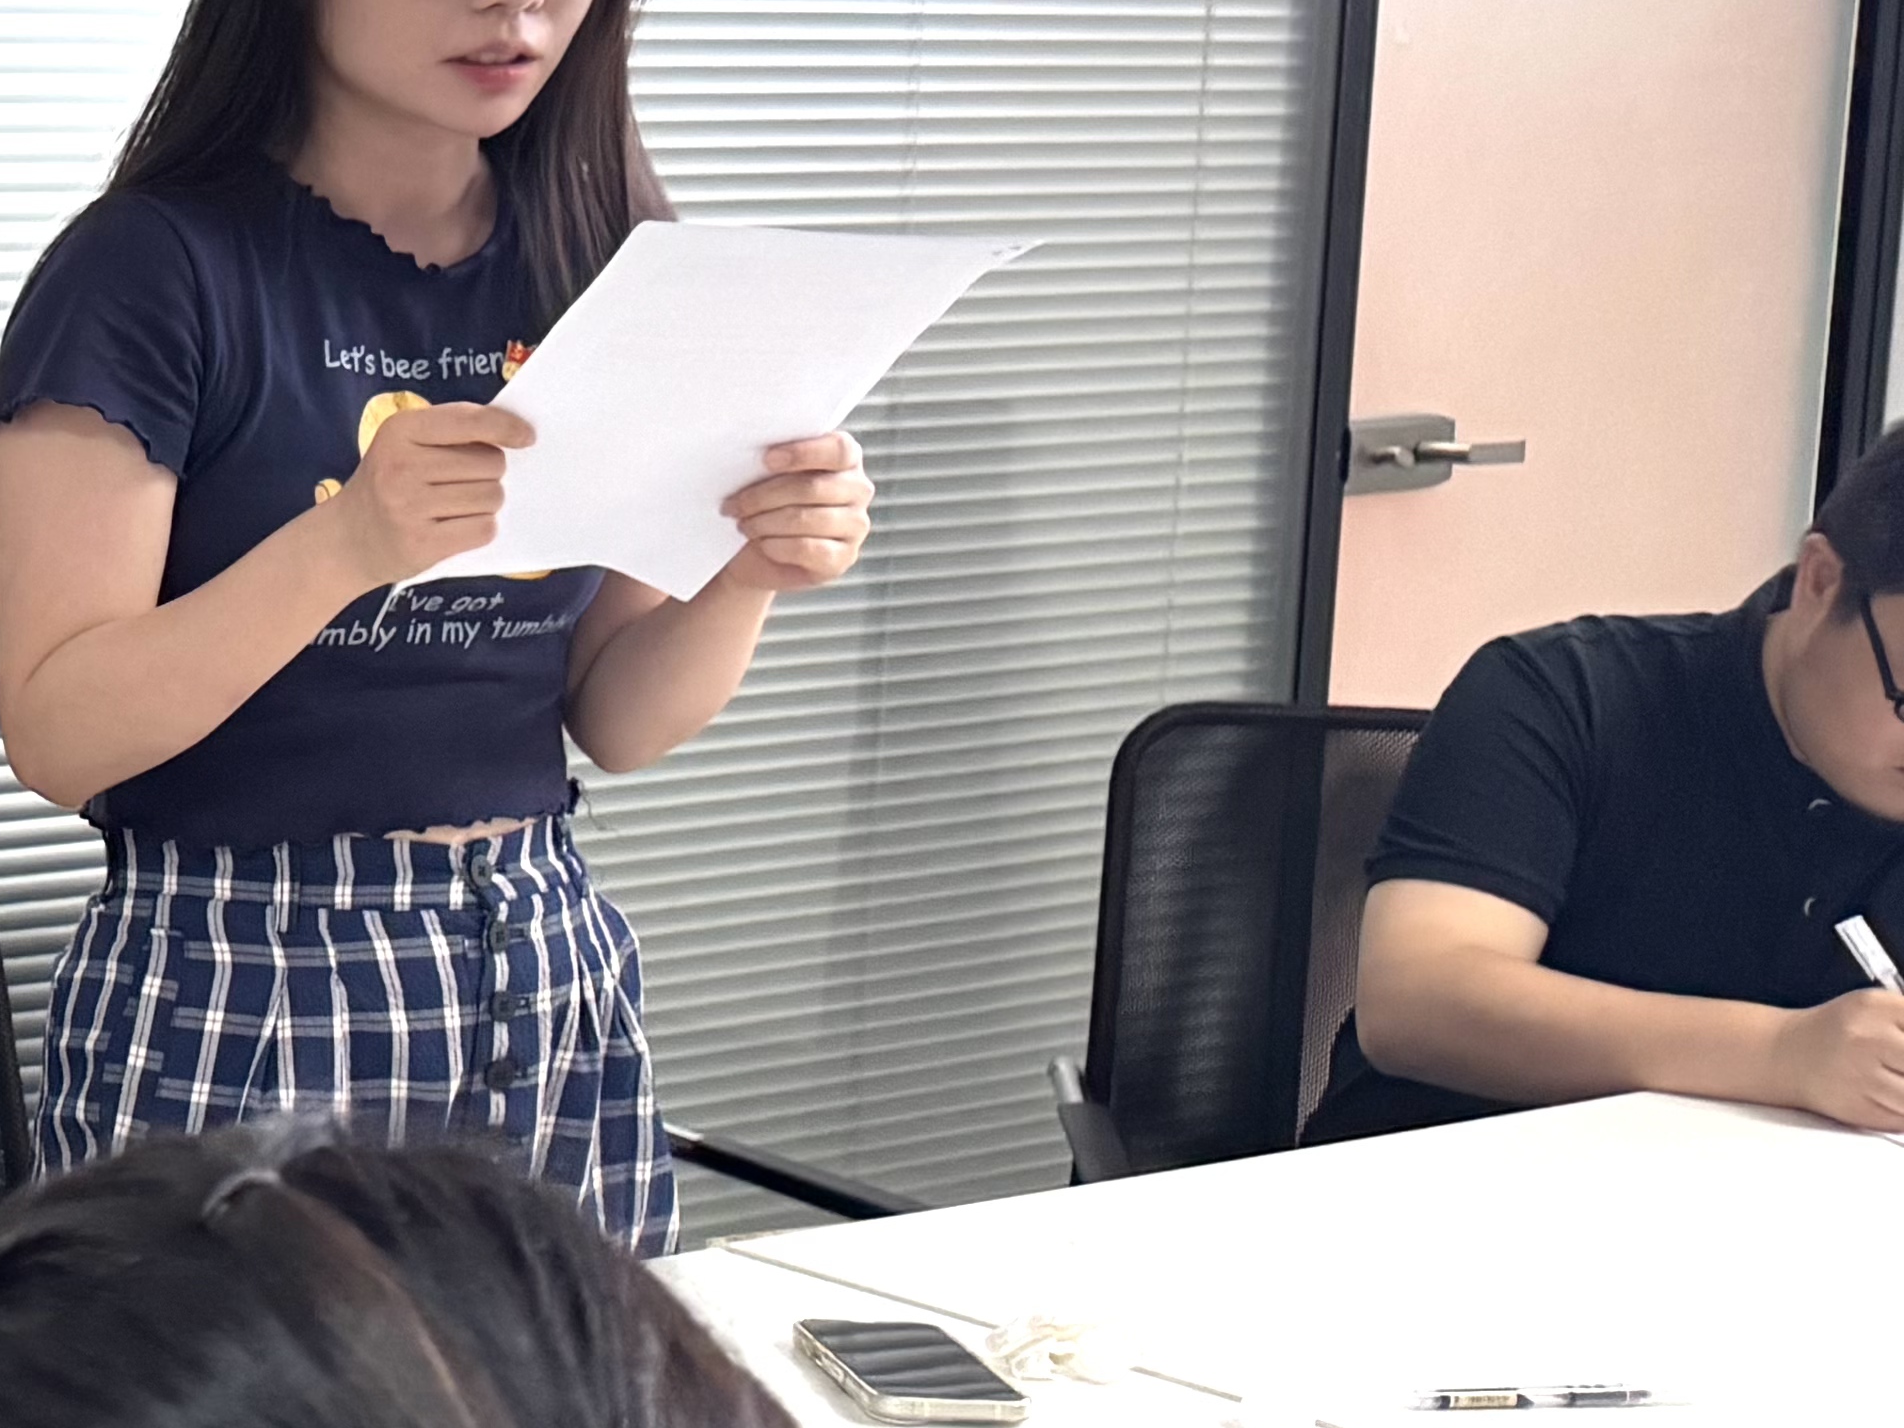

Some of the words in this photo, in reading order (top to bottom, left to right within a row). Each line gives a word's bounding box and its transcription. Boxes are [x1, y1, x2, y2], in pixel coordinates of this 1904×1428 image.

[324, 339, 375, 375] Let's
[380, 349, 430, 380] bee
[438, 348, 504, 380] frien
[388, 589, 442, 613] I've
[445, 593, 504, 615] got
[310, 619, 396, 652] mbly
[406, 619, 431, 644] in
[442, 621, 480, 649] my
